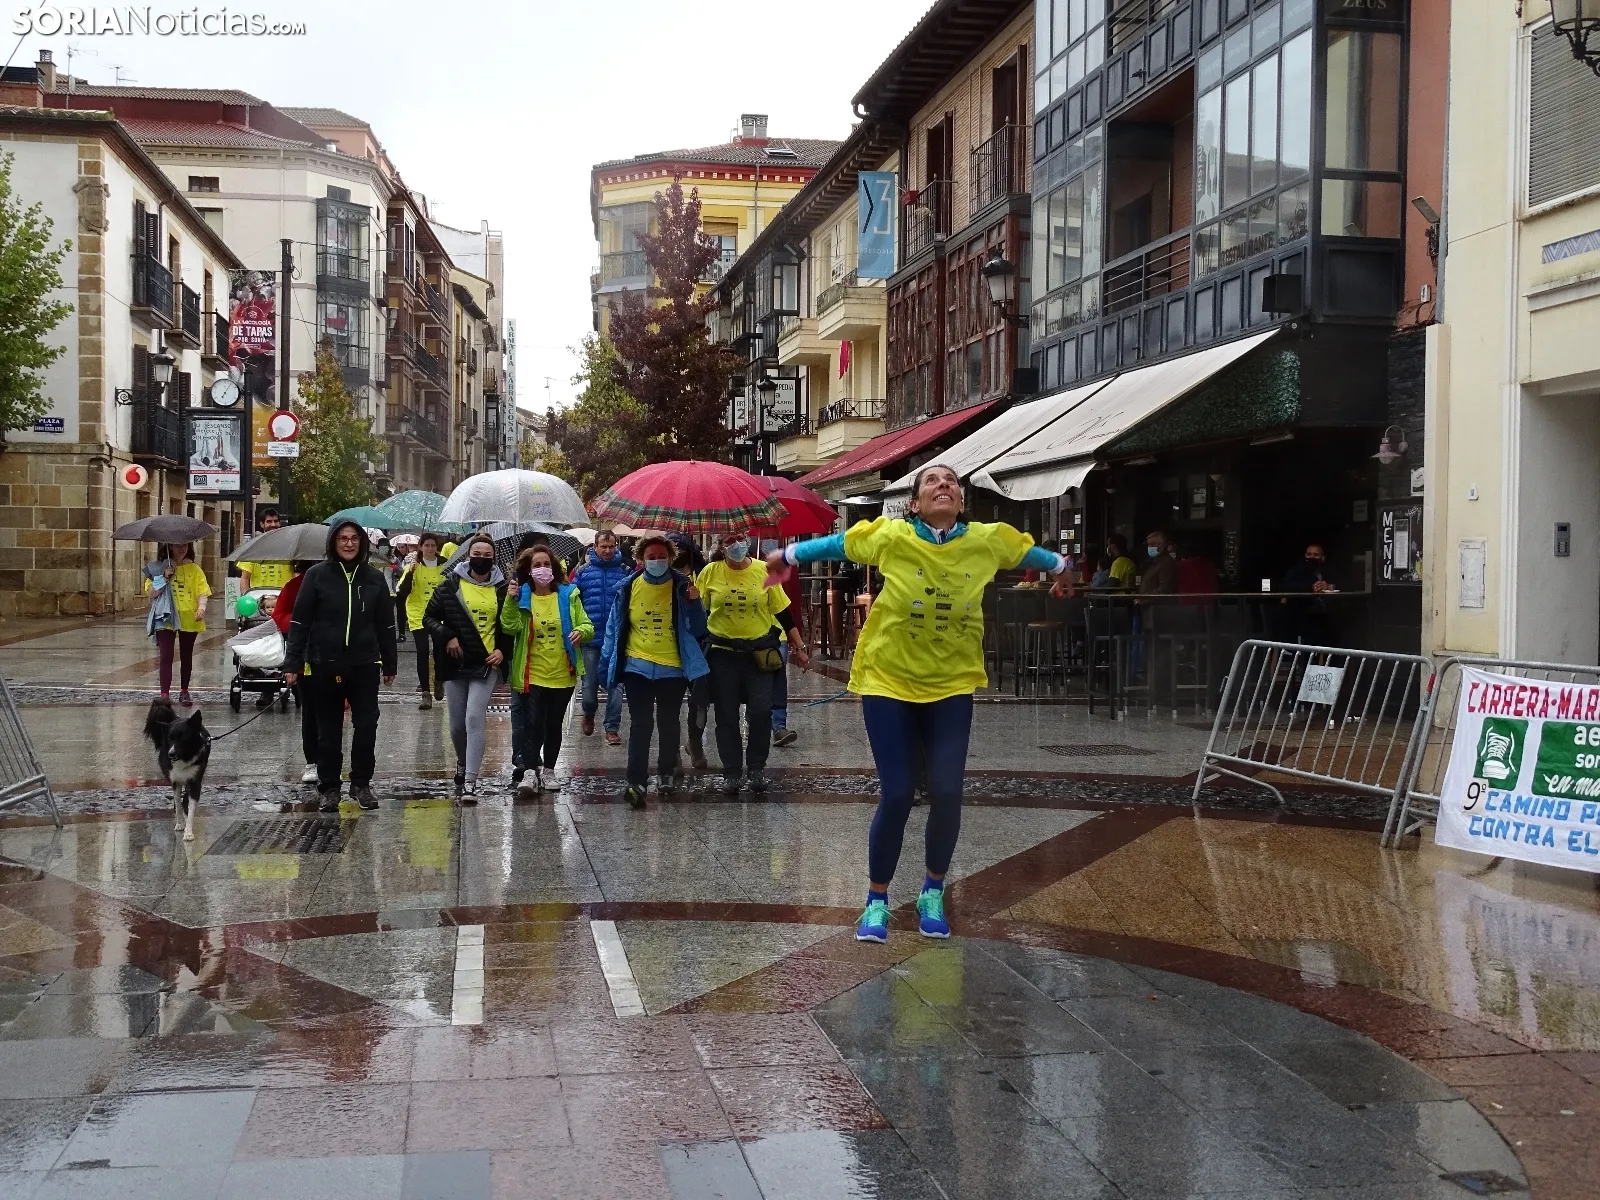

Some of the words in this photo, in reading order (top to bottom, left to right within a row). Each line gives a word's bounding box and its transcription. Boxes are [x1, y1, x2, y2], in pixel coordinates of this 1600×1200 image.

[232, 325, 244, 336] DE
[245, 326, 273, 337] TAPAS
[1382, 511, 1394, 580] MENÚ
[1484, 790, 1572, 822] CAMINO
[1468, 815, 1555, 848] CONTRA
[1567, 830, 1599, 855] EL
